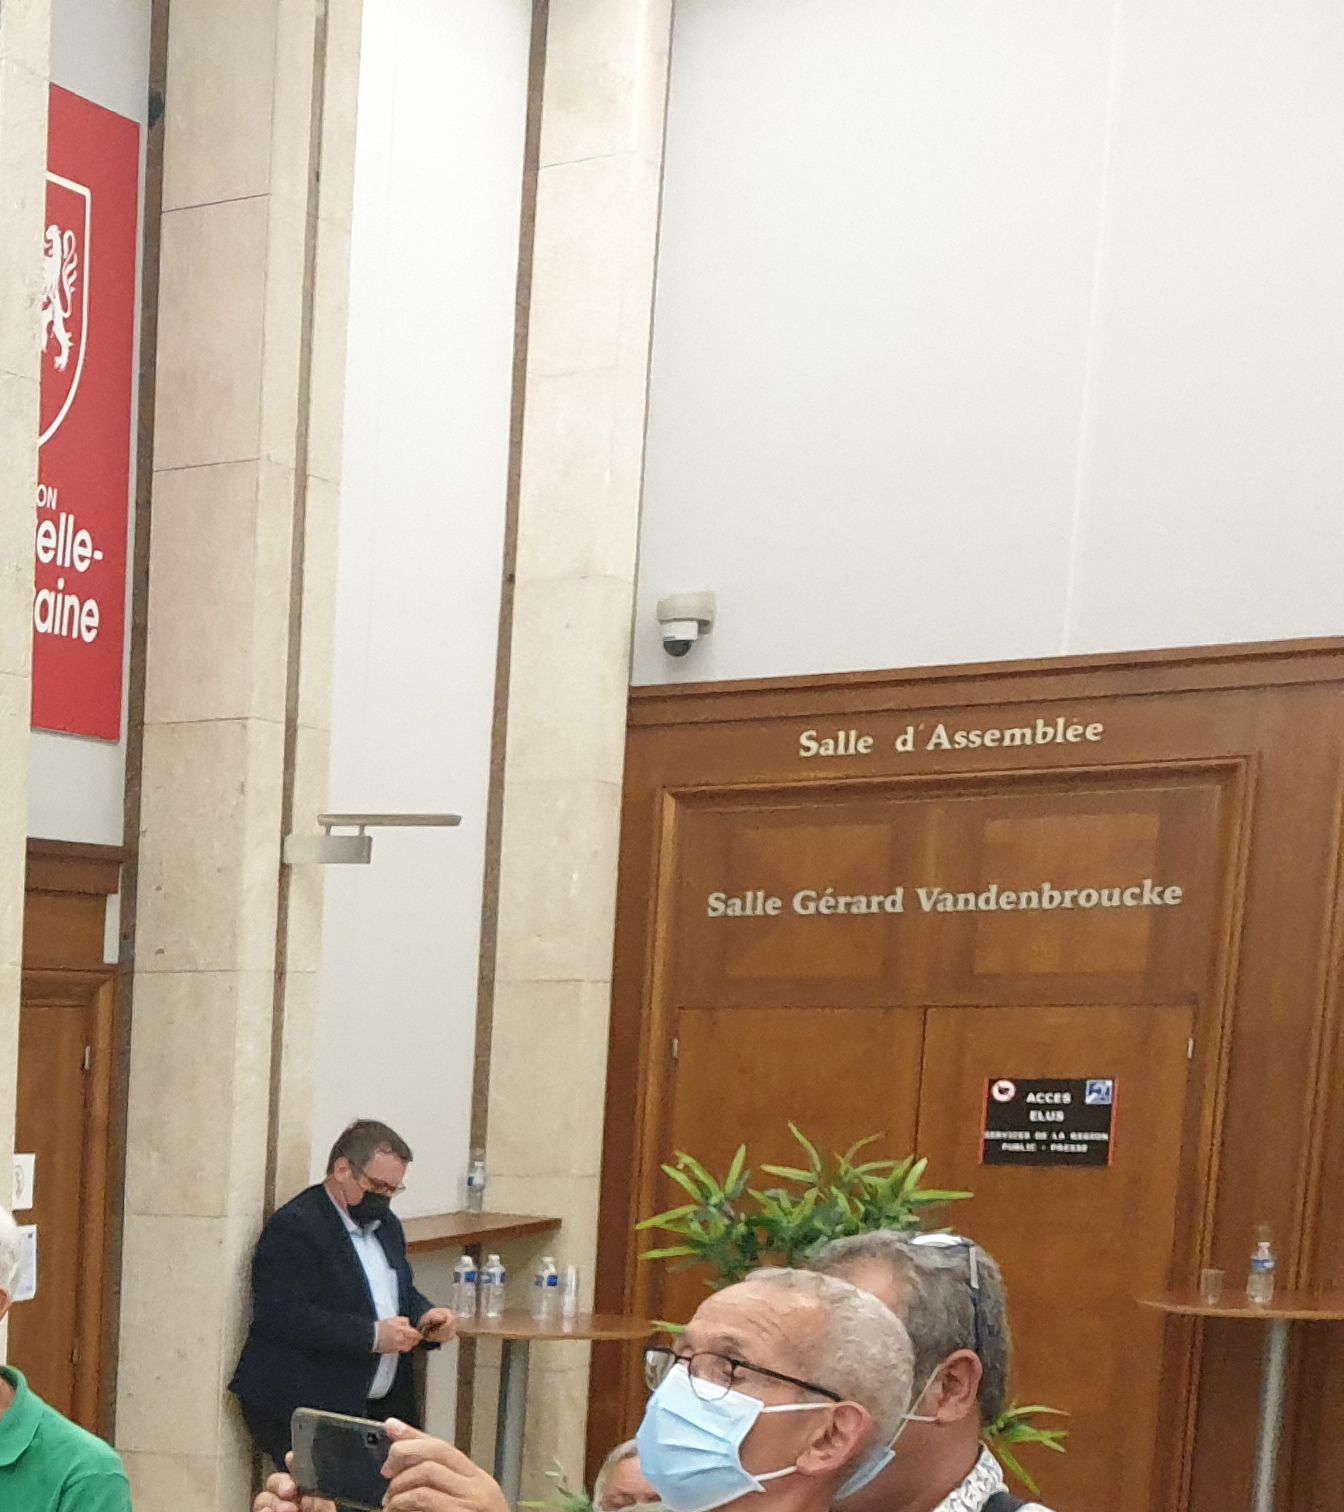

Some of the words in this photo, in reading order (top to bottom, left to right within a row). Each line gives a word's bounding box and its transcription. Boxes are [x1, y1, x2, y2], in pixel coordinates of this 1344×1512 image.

[36, 511, 104, 573] elle-
[34, 577, 100, 643] aine
[799, 729, 874, 757] Salle
[706, 889, 782, 917] Salle
[792, 887, 905, 915] Gérard
[915, 878, 1184, 913] Vandenbroucke
[1025, 1091, 1072, 1104] ACCES
[1029, 1110, 1065, 1122] ELUS
